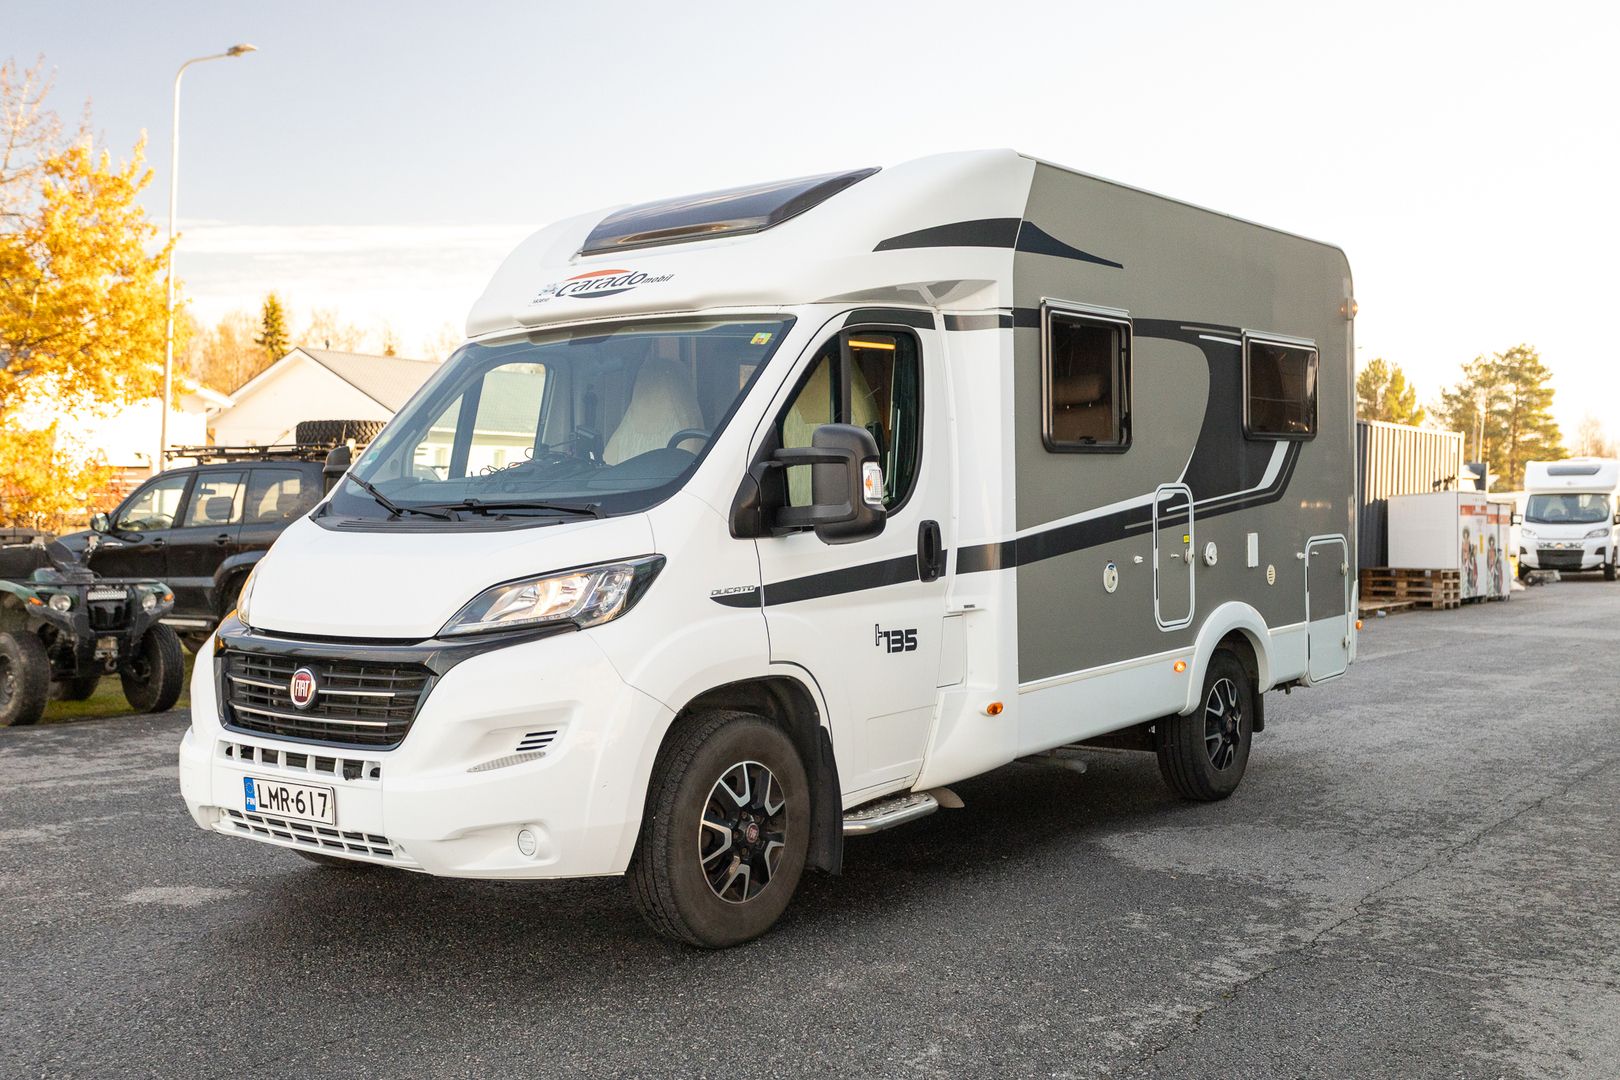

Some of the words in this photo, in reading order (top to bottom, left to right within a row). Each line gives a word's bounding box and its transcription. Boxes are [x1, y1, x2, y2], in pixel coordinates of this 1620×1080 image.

[555, 270, 648, 298] carado
[641, 274, 675, 284] mobil
[711, 585, 755, 596] DUCATO
[294, 679, 311, 697] FIAT
[257, 783, 327, 818] LMR-617
